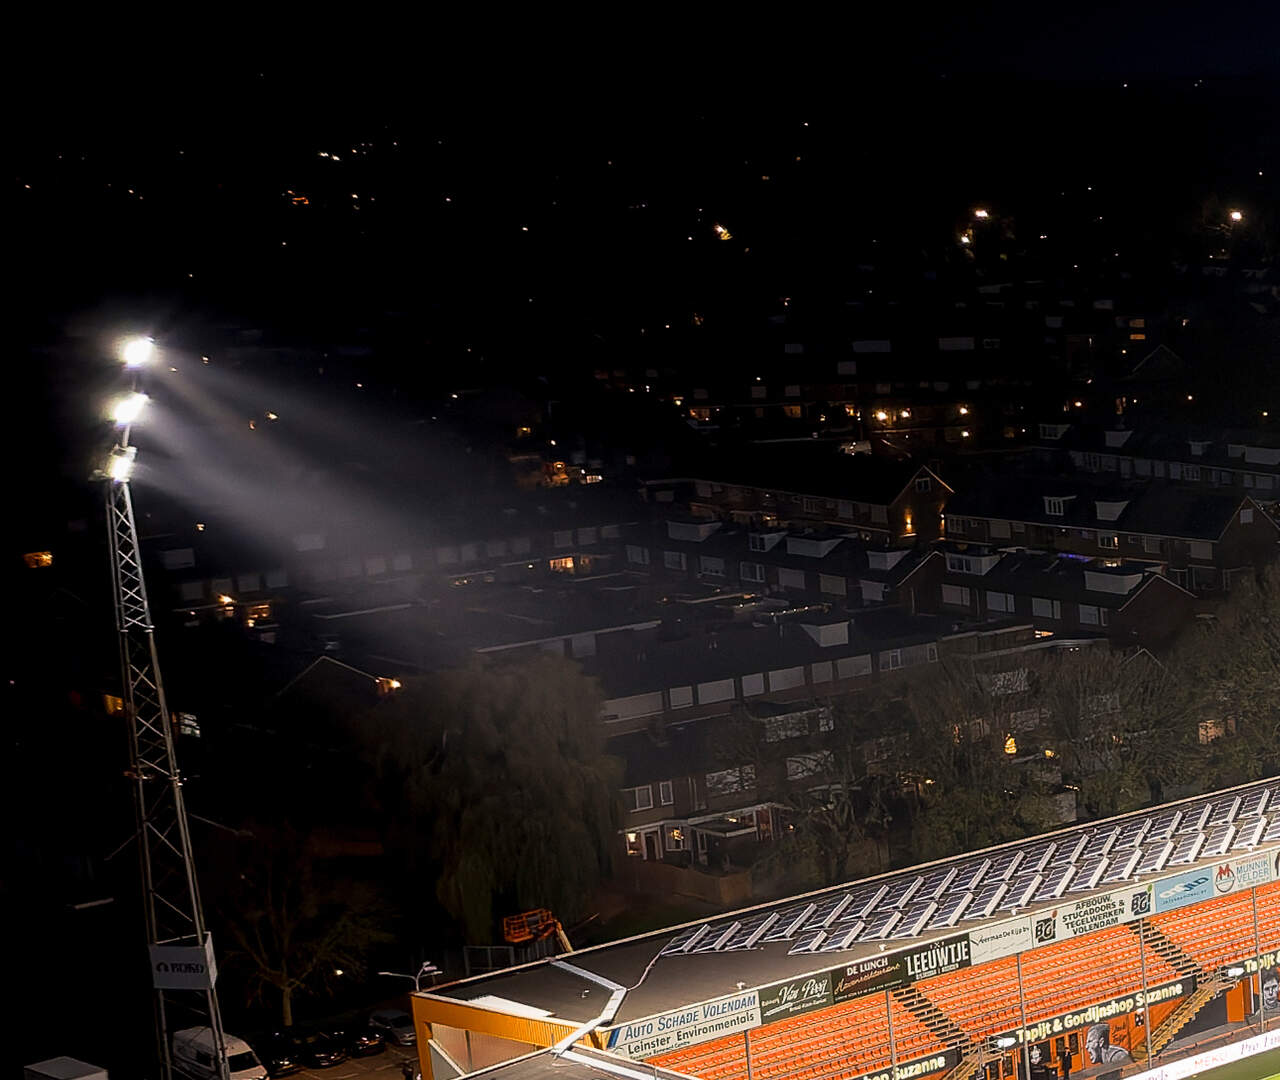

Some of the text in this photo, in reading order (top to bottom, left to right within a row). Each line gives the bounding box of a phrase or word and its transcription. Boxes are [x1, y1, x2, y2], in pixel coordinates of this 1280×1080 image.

[1236, 860, 1269, 874] MUNNIK
[1236, 869, 1270, 884] VELDER
[1062, 902, 1117, 923] STUCADOORS
[1064, 908, 1125, 929] TEGELWERKEN
[1072, 916, 1119, 935] VOLENDAM
[847, 957, 889, 976] DE LUNCH
[907, 940, 969, 976] LEEUWTJE
[779, 986, 799, 1005] Van
[624, 995, 756, 1041] AUTO SCHADE VOLENDAM
[1016, 1024, 1052, 1043] Tapijt
[1052, 1019, 1063, 1033] &
[1064, 997, 1133, 1029] Gordijnshop
[627, 1035, 671, 1055] Leinster
[676, 1012, 755, 1041] Environmentals
